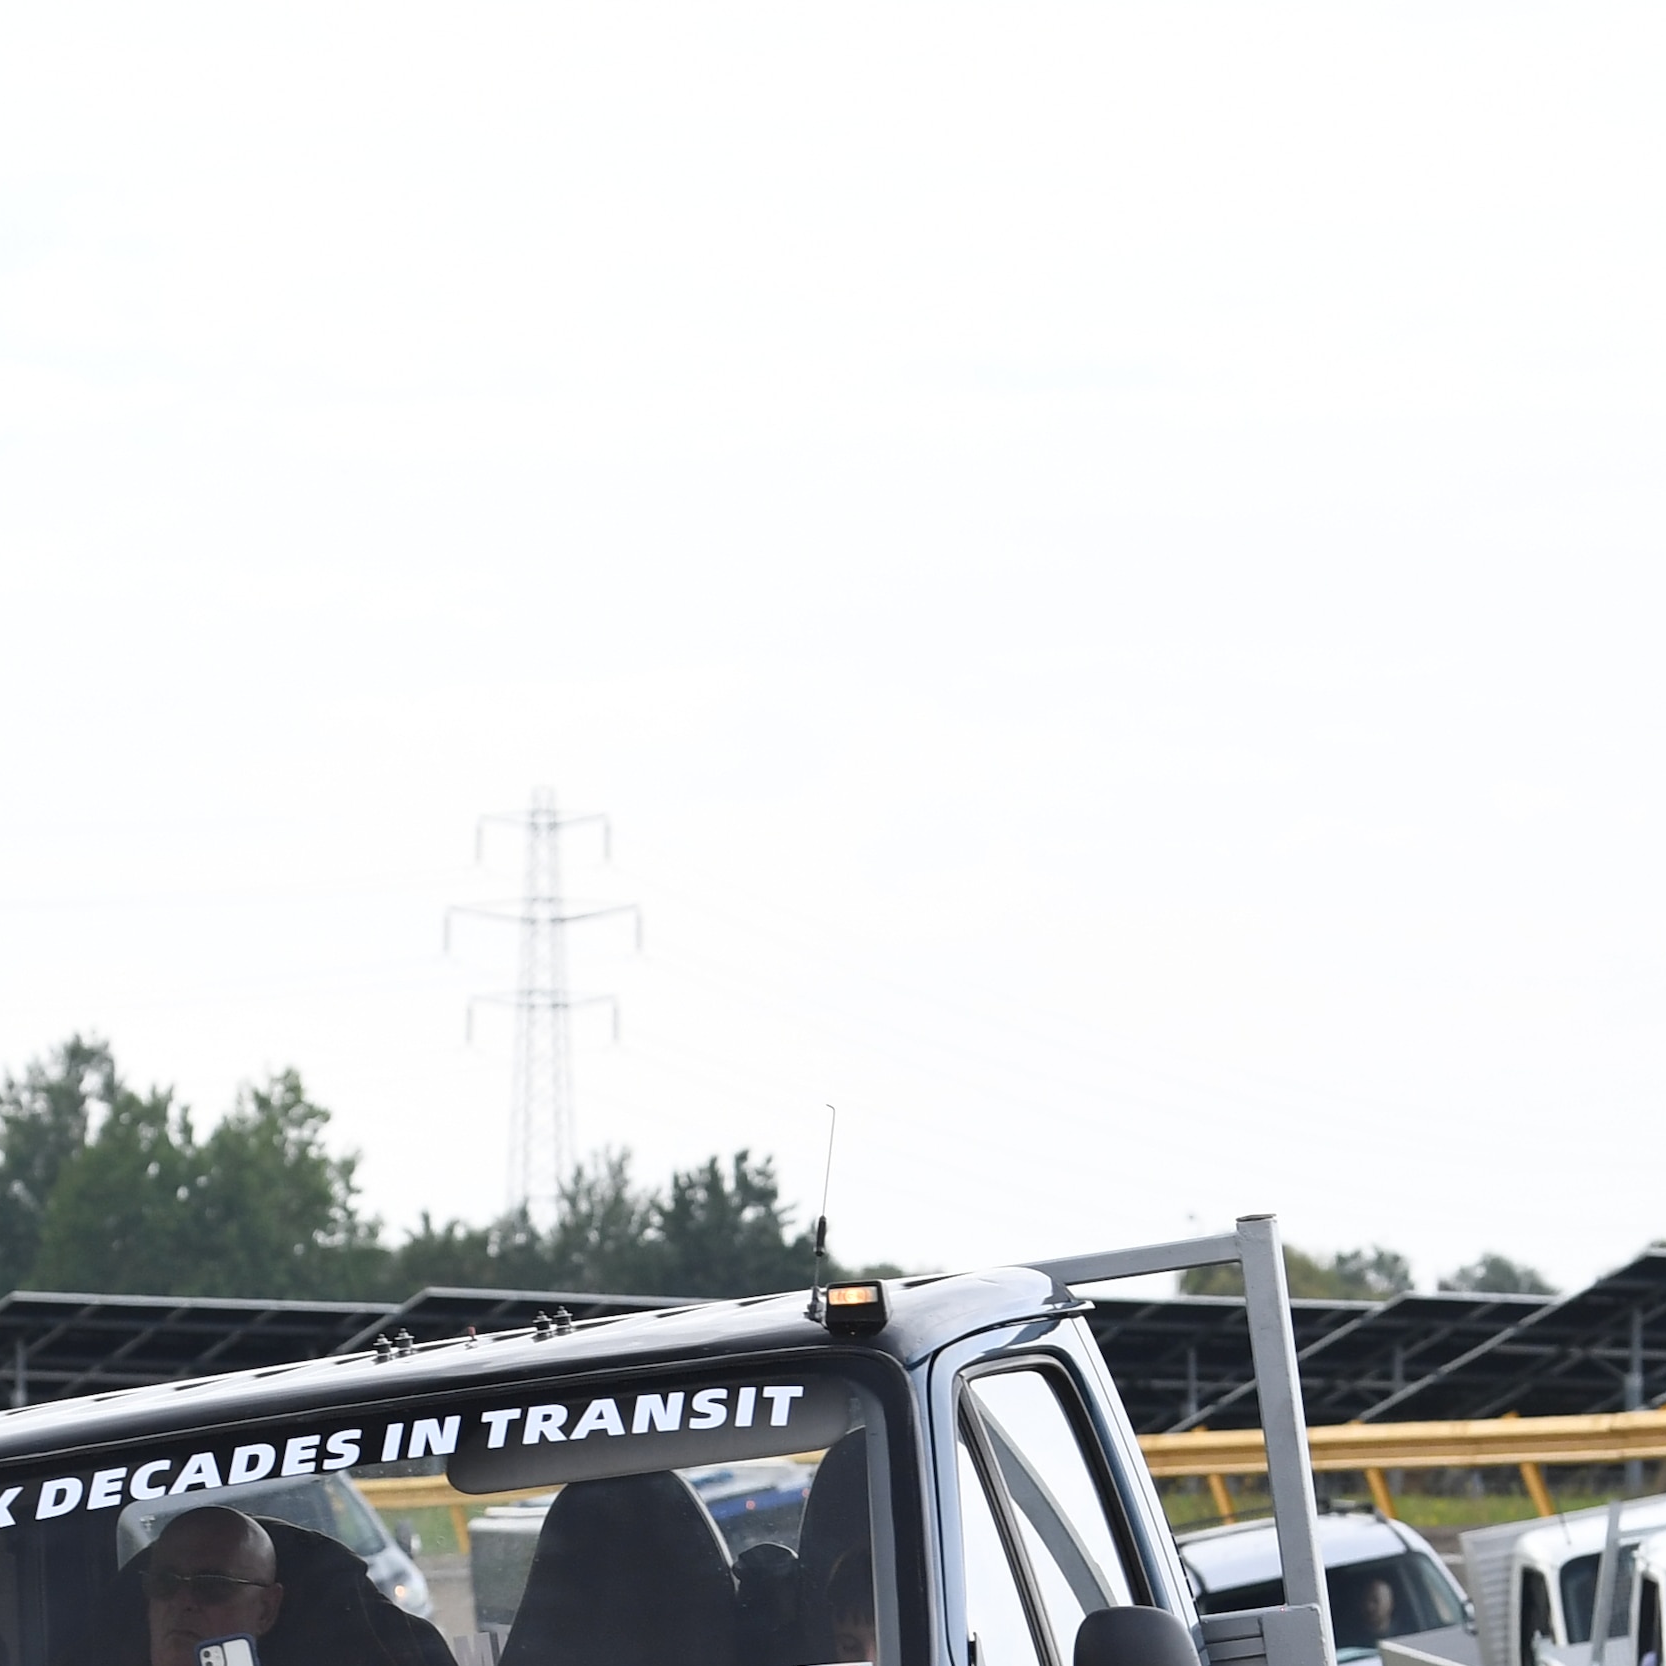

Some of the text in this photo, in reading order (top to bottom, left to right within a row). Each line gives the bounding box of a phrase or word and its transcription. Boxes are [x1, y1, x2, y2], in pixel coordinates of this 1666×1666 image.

[35, 1428, 363, 1521] DECADES
[381, 1415, 461, 1462] IN
[480, 1385, 804, 1449] TRANSIT
